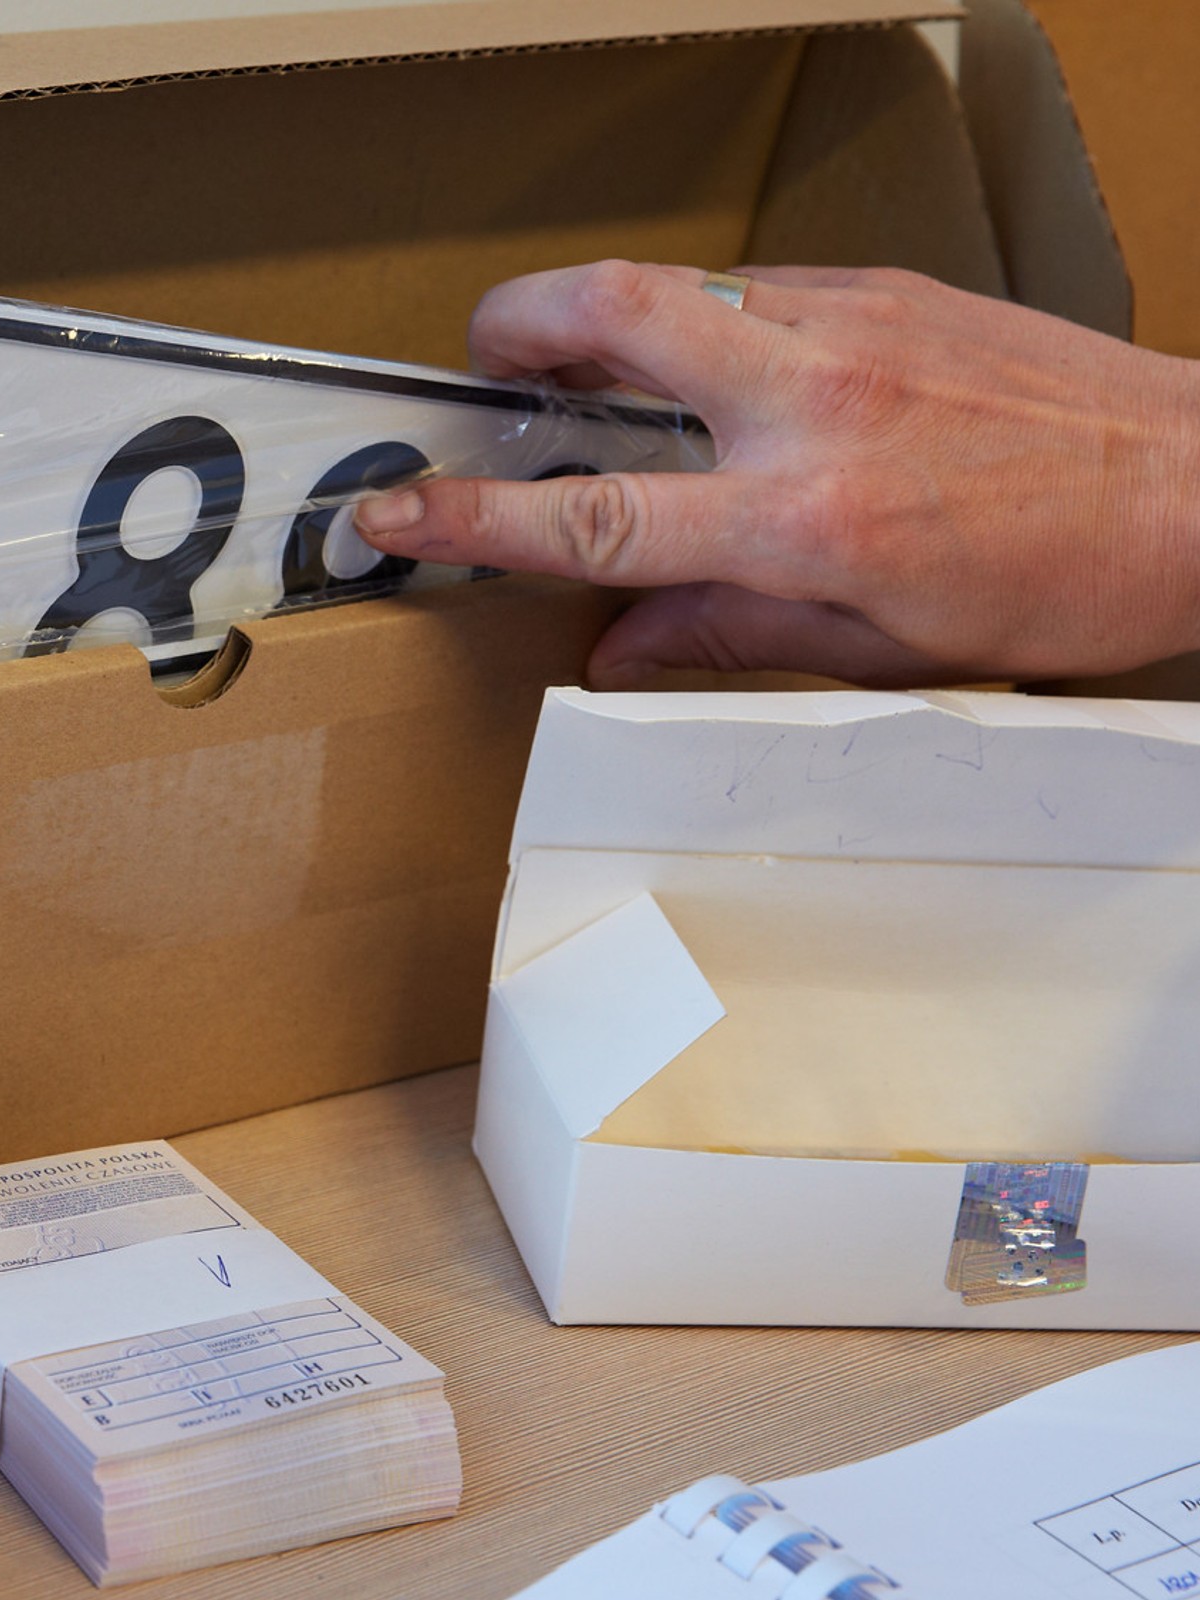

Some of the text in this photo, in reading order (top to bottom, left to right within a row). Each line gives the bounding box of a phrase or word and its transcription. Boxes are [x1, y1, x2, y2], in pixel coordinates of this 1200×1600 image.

[99, 1150, 164, 1166] POLSKA
[86, 1160, 177, 1181] CZASOWE
[303, 1362, 323, 1374] H
[264, 1373, 372, 1410] 6427601
